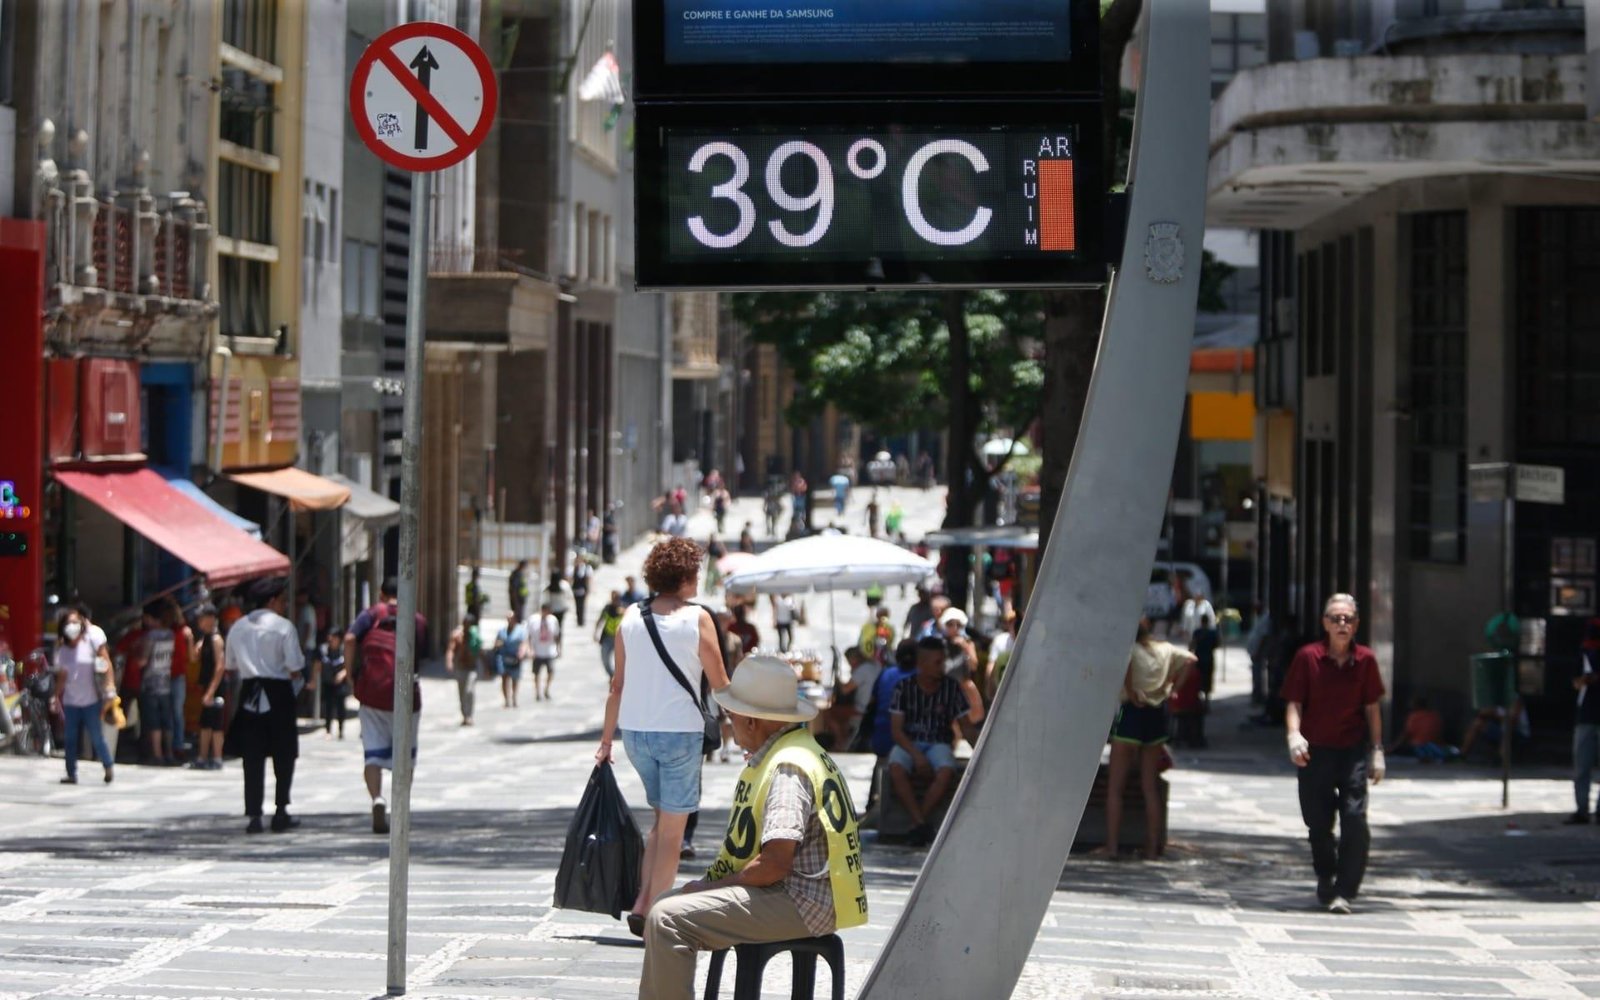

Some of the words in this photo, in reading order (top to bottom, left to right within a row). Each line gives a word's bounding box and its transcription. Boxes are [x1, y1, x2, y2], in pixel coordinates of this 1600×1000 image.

[683, 10, 723, 20] COMPRE
[725, 10, 731, 19] E
[733, 9, 768, 19] GANHE
[770, 9, 783, 19] DA
[786, 8, 834, 19] SAMSUNG
[1038, 136, 1071, 157] AR
[1023, 159, 1037, 246] RUIM
